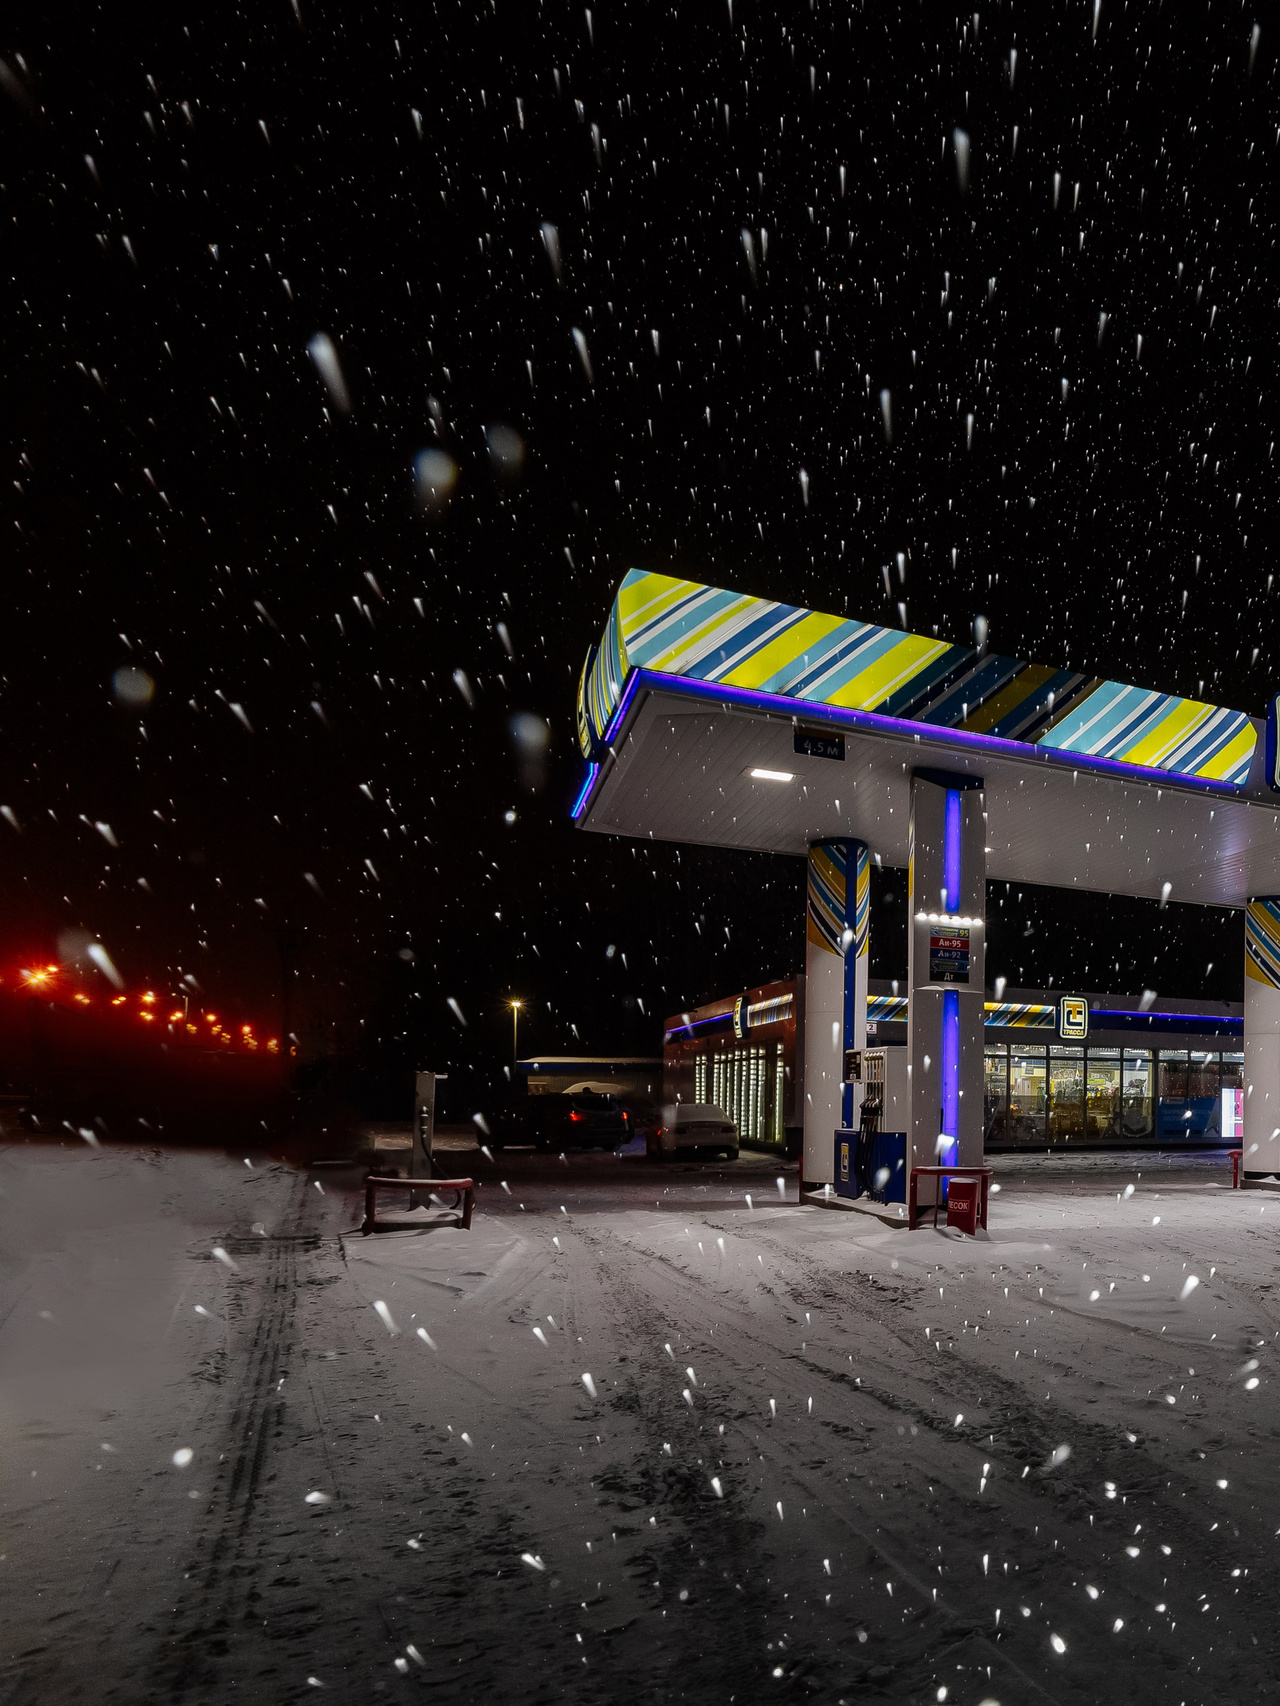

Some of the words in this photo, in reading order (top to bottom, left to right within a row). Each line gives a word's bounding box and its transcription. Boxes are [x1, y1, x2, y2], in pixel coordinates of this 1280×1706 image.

[804, 740, 824, 753] 4.5
[960, 930, 969, 938] 95
[939, 939, 961, 948] Аи-95
[938, 950, 961, 959] Аи-92
